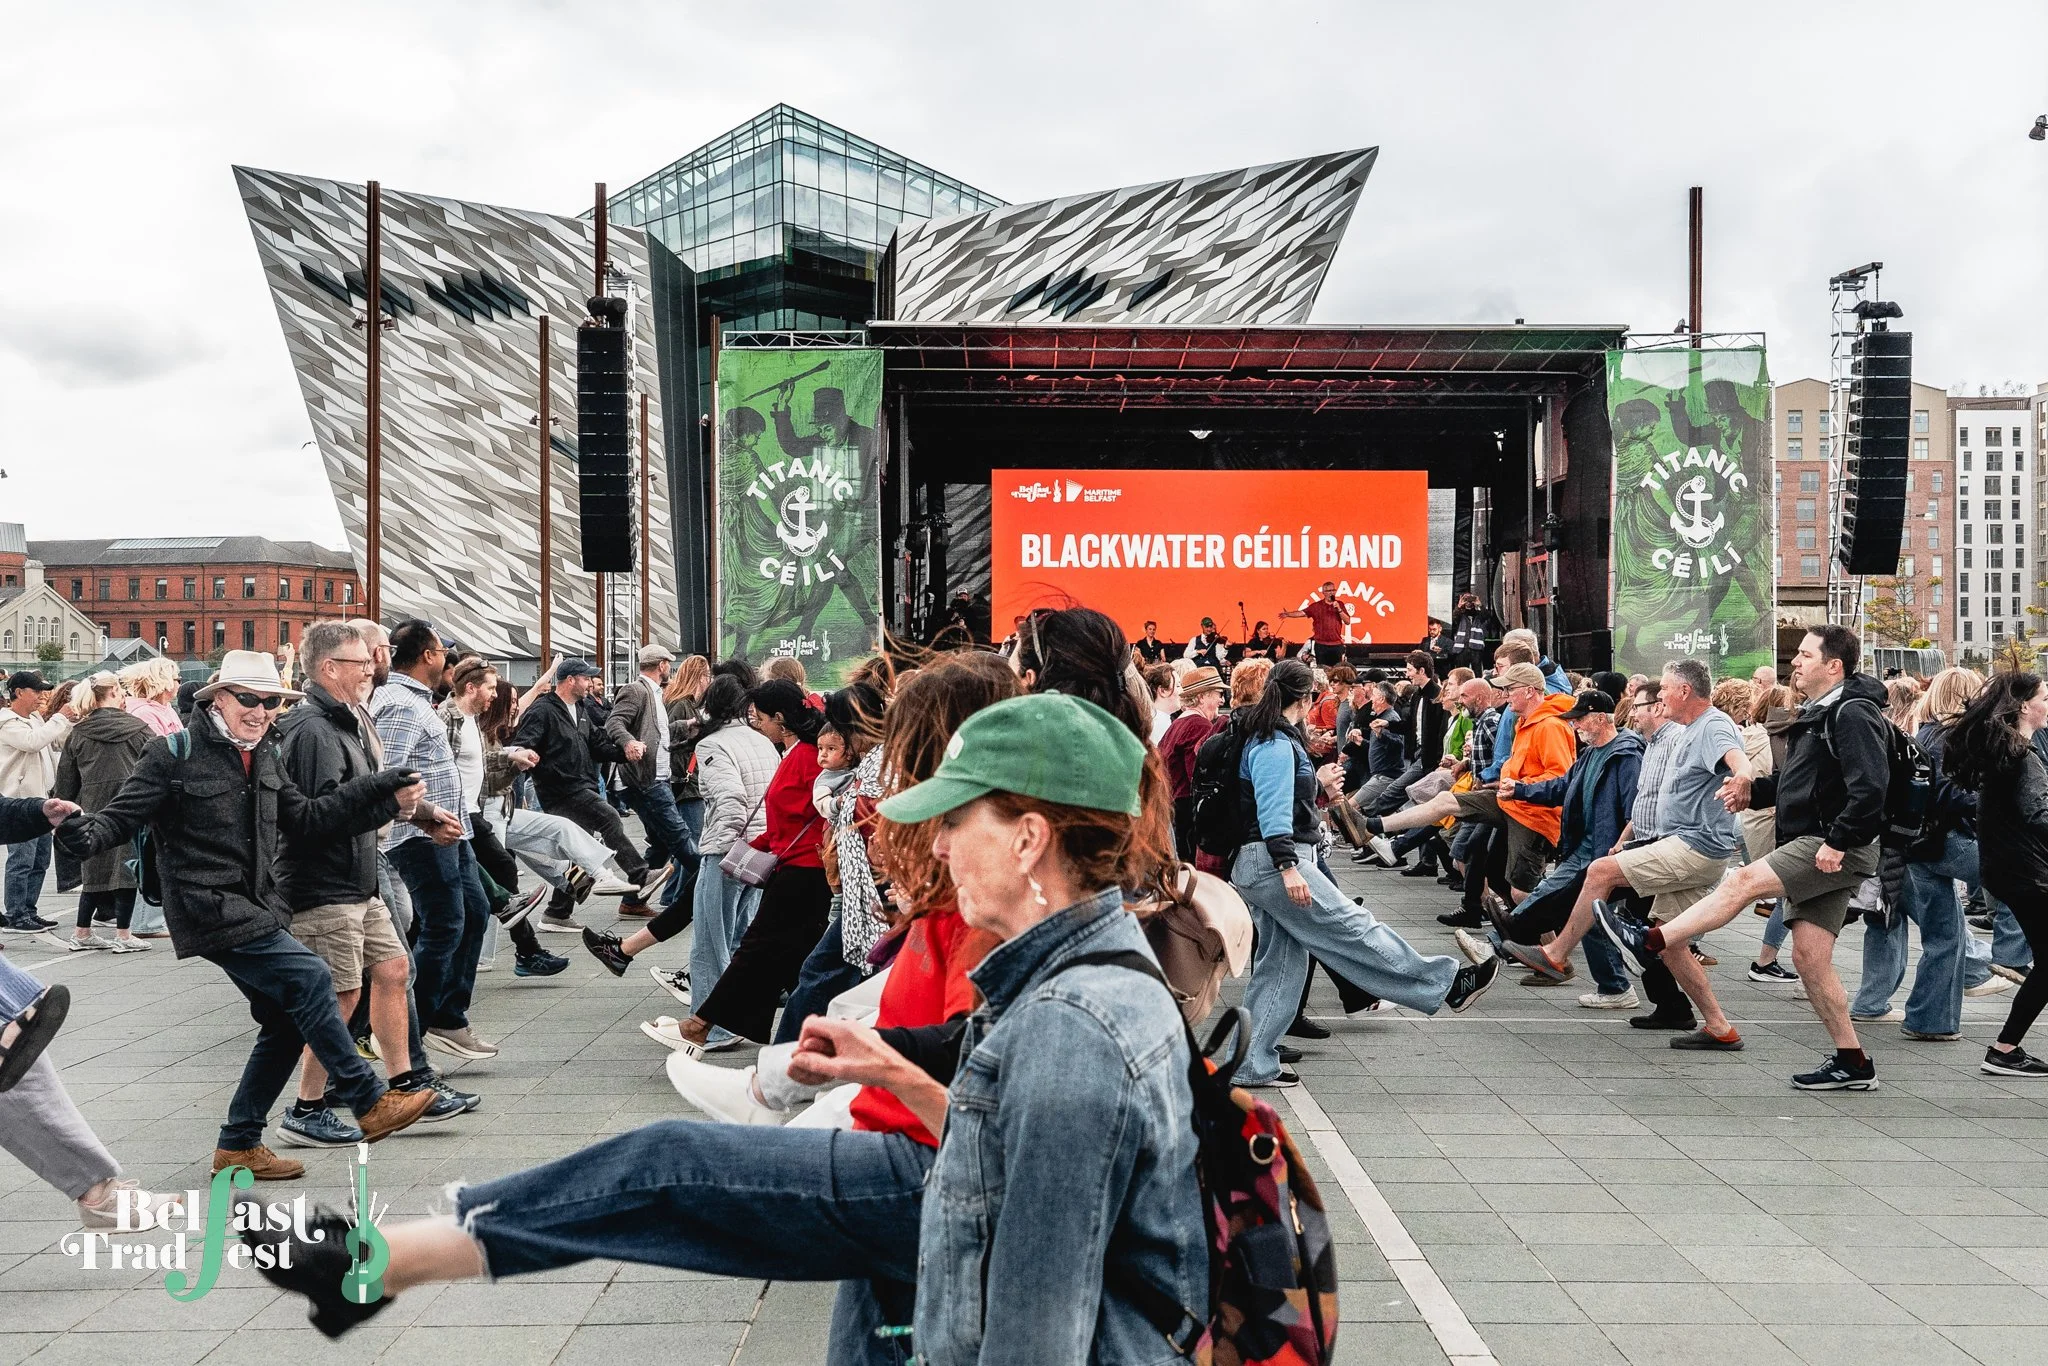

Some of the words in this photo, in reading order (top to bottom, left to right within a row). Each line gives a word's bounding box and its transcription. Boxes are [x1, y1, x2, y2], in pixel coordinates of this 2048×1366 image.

[746, 458, 853, 501] TITANIC
[1640, 447, 1748, 494] TITANIC
[1021, 533, 1225, 569] BLACKWATER
[1233, 525, 1310, 569] CÉILÍ
[1318, 534, 1401, 569] BAND
[1651, 541, 1742, 579] CÉILÍ
[759, 549, 845, 586] CÉILÍ
[780, 635, 819, 651] Belfast
[1674, 628, 1717, 645] Belfast
[284, 1117, 306, 1131] HOKA
